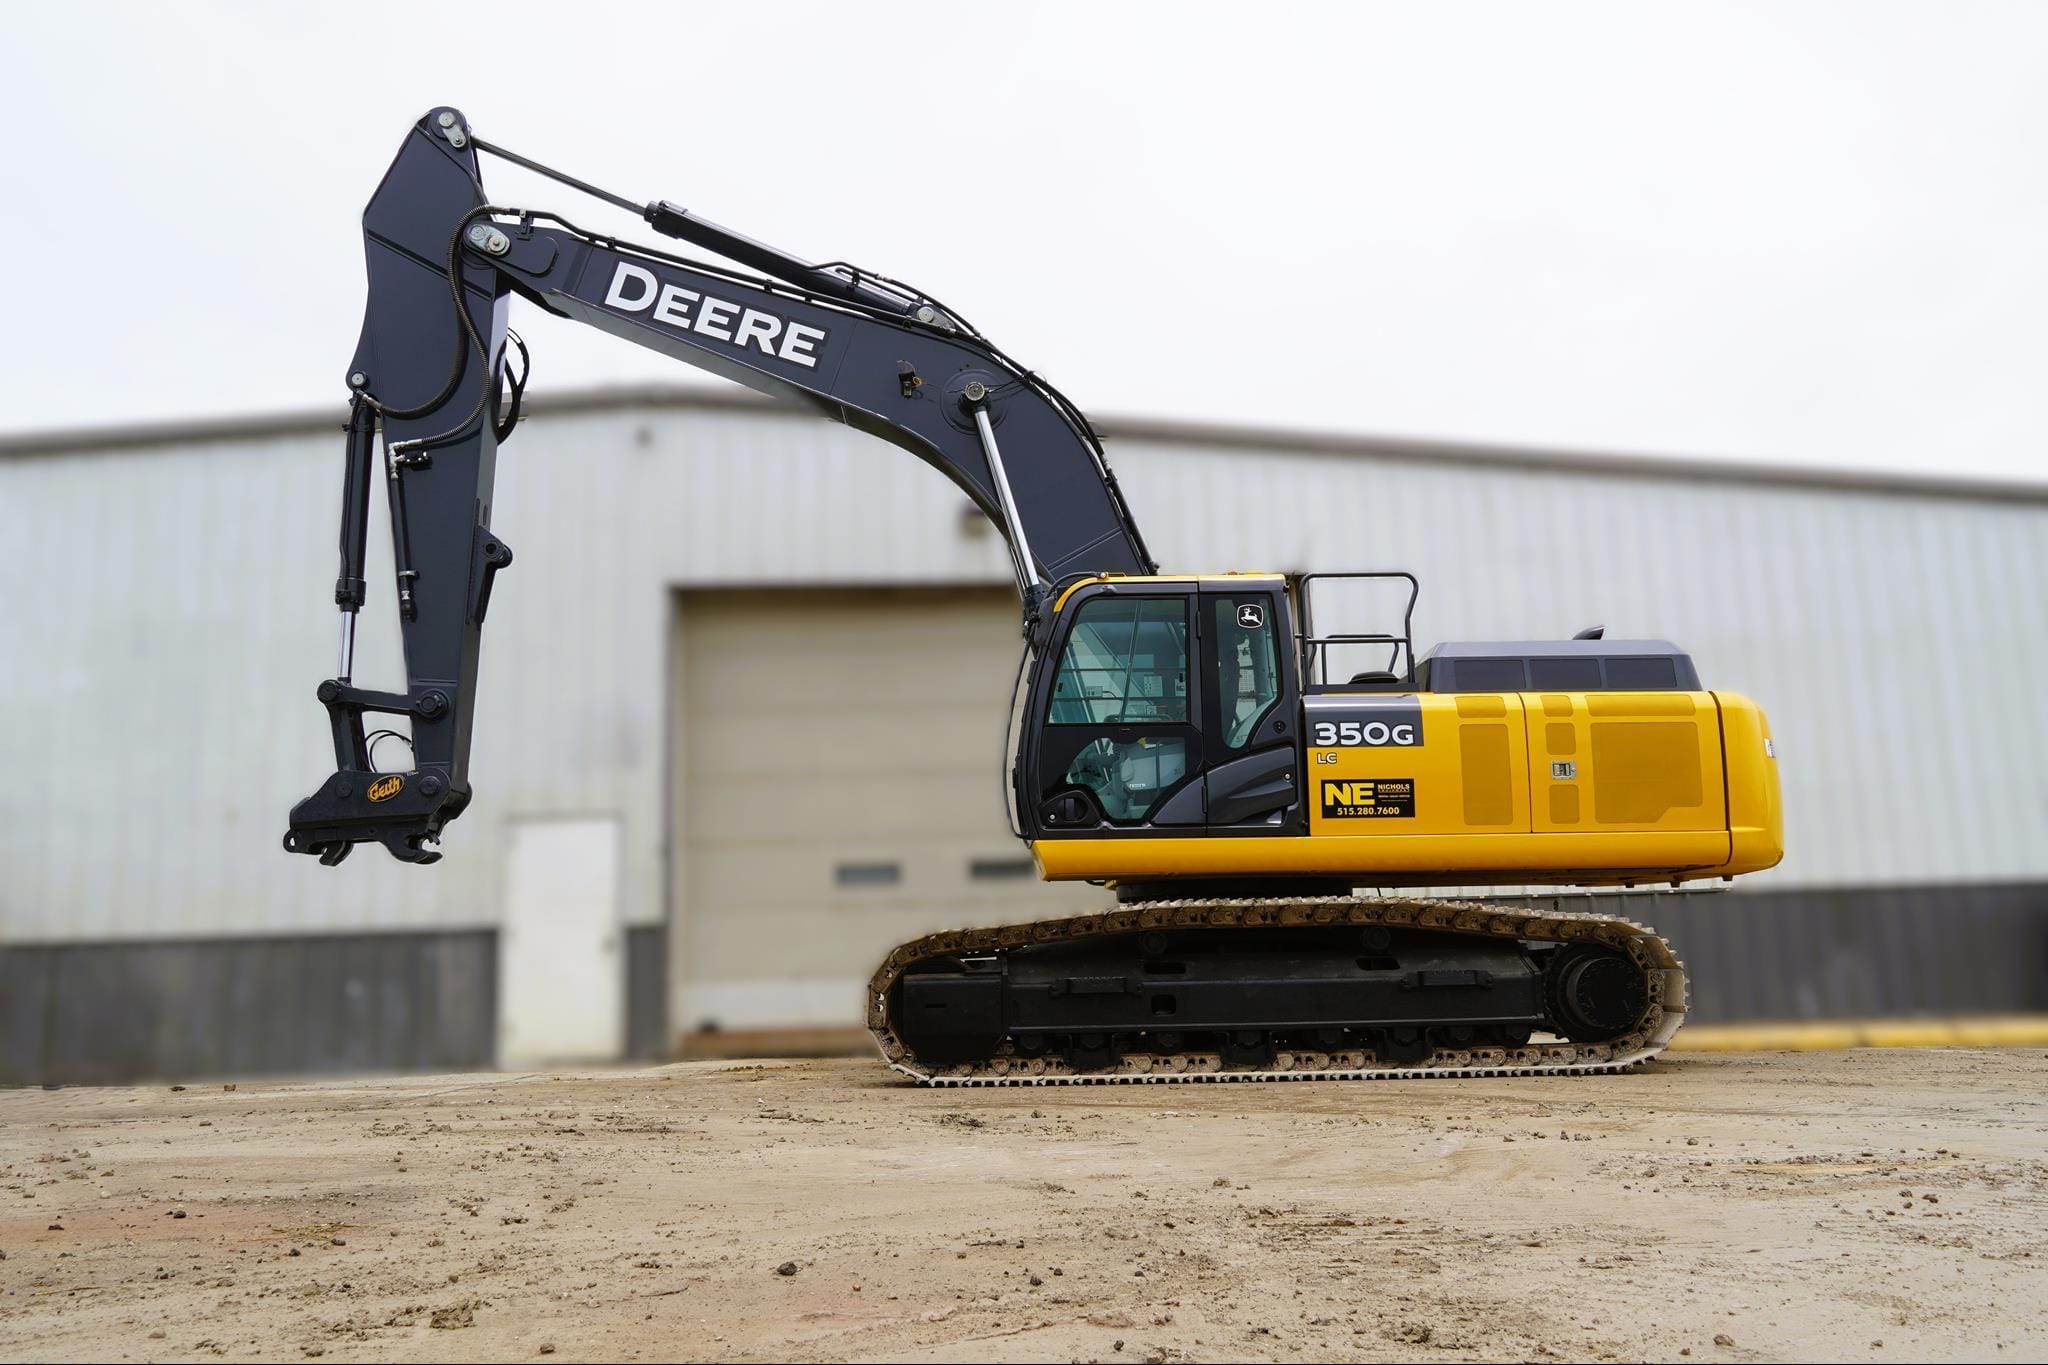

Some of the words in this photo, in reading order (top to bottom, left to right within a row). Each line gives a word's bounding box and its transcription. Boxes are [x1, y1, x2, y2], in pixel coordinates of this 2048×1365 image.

[605, 262, 825, 367] DEERE
[1315, 722, 1414, 746] 350G
[1317, 753, 1337, 764] LC
[1325, 783, 1375, 806] NE
[1337, 807, 1400, 815] 515.280.7600
